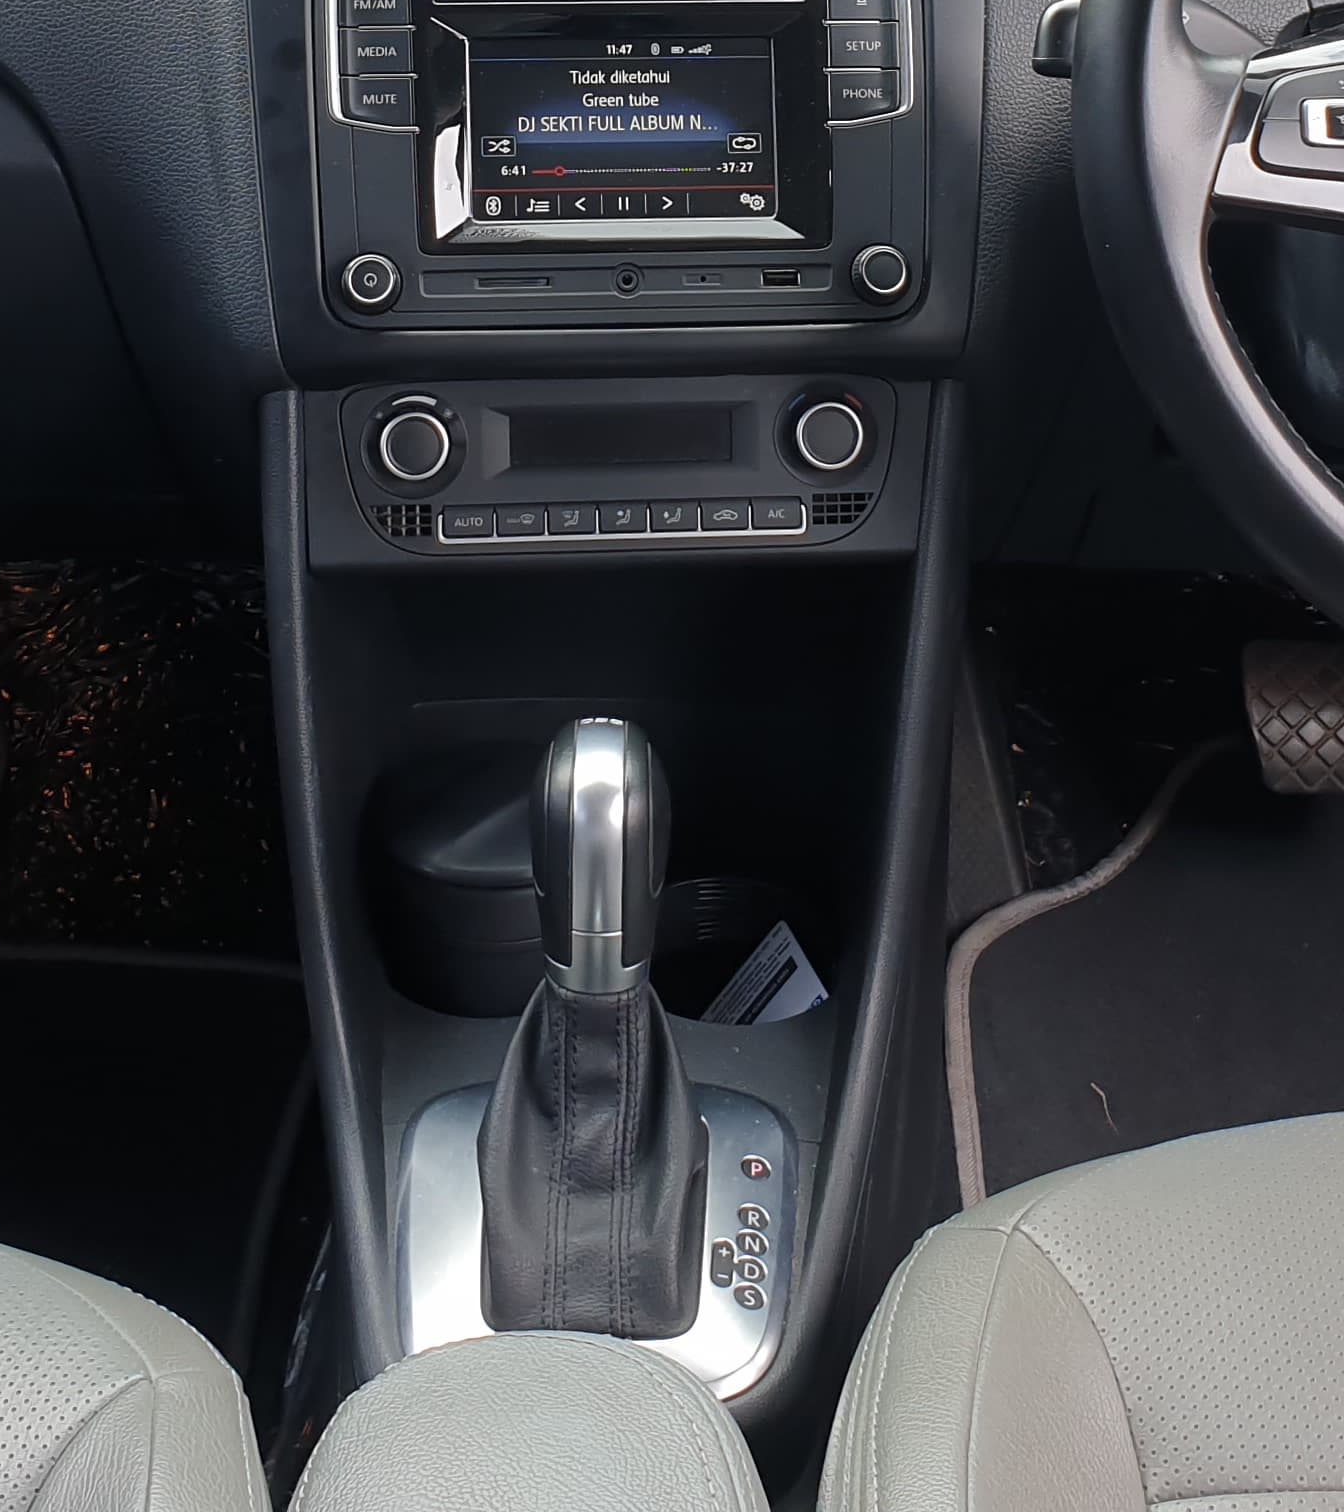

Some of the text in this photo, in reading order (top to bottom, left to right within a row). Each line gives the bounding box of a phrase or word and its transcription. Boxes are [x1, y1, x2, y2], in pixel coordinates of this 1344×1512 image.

[353, 0, 397, 10] FM/AM
[357, 46, 398, 58] MEDIA
[605, 43, 634, 56] 11:47
[845, 40, 882, 52] SETUP
[569, 69, 671, 85] Tidak diketahui
[362, 94, 398, 105] MUTE
[582, 92, 660, 108] Green tube
[842, 88, 884, 100] PHONE
[517, 116, 536, 133] DJ
[541, 115, 583, 133] SEKTI
[588, 114, 625, 132] FULL
[630, 114, 684, 131] ALBUM
[500, 165, 528, 177] 6:41
[767, 508, 786, 519] A/C
[453, 515, 484, 528] AUTO
[750, 1161, 763, 1177] P
[747, 1210, 761, 1228] R
[744, 1237, 760, 1253] N
[743, 1263, 760, 1280] D
[743, 1289, 756, 1306] S
